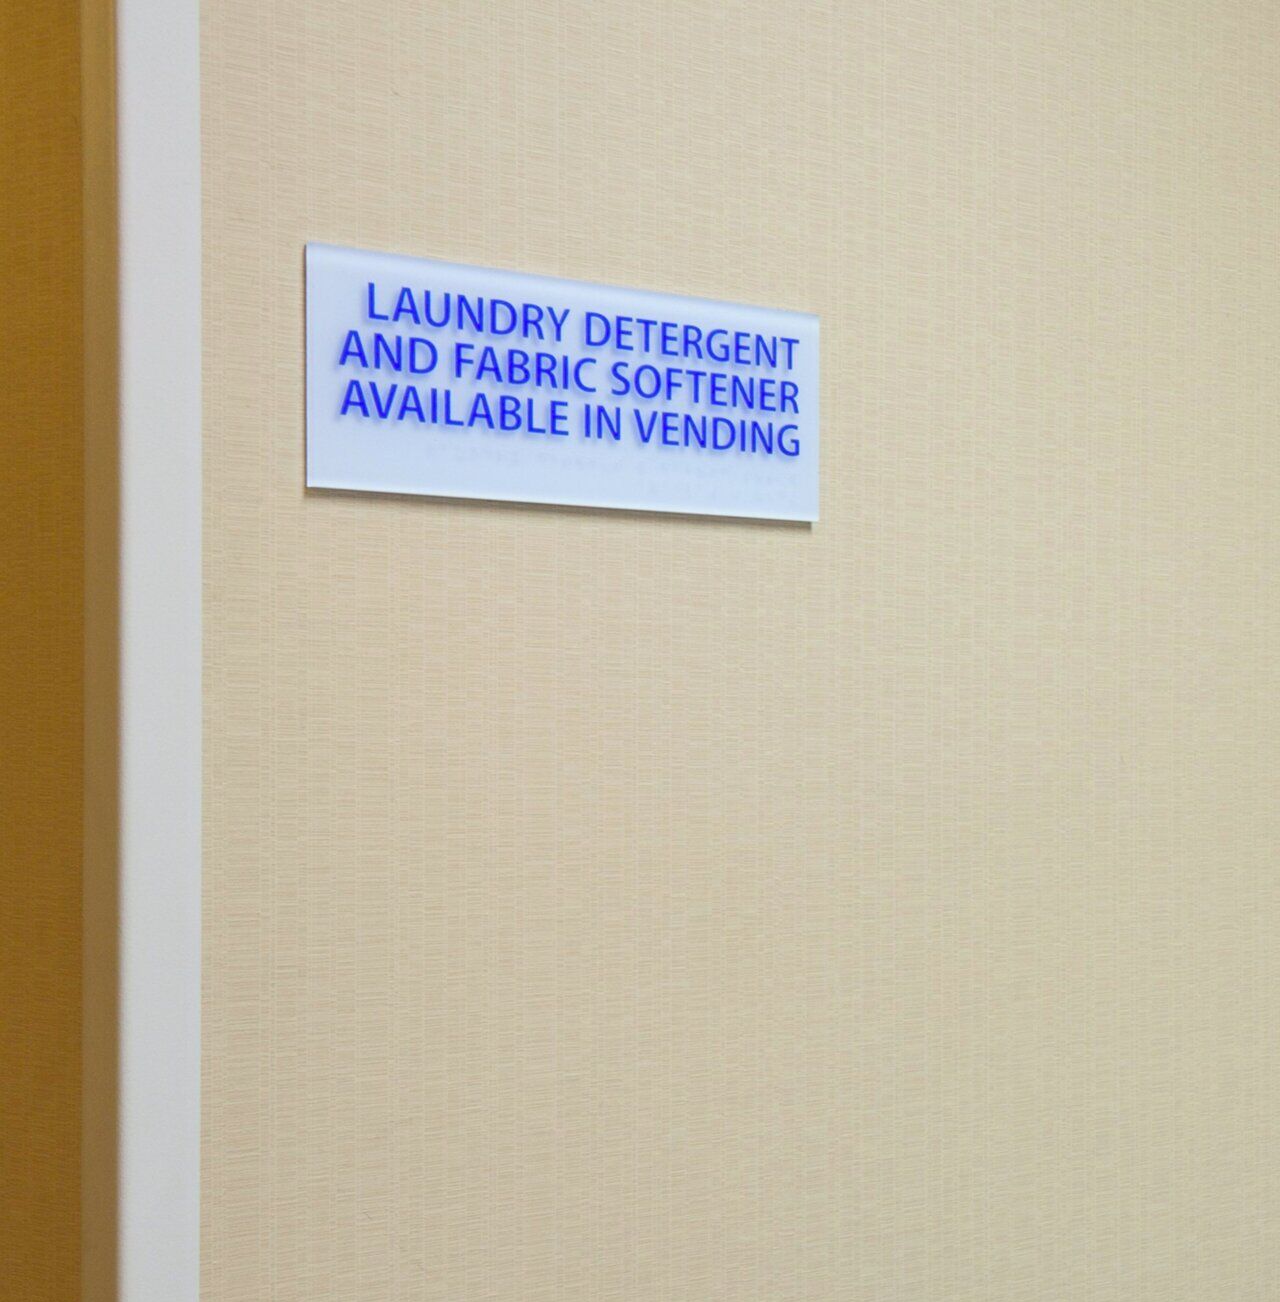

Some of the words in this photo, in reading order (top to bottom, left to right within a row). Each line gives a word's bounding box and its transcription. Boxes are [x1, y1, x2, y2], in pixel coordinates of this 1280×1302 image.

[367, 282, 570, 342] LAUNDRY
[584, 311, 799, 370] DETERGENT
[339, 329, 439, 376] AND
[452, 342, 597, 394] FABRIC
[610, 361, 799, 414] SOFTENER
[340, 379, 569, 437] AVAILABLE
[583, 404, 622, 441] IN
[633, 408, 801, 458] VENDING
